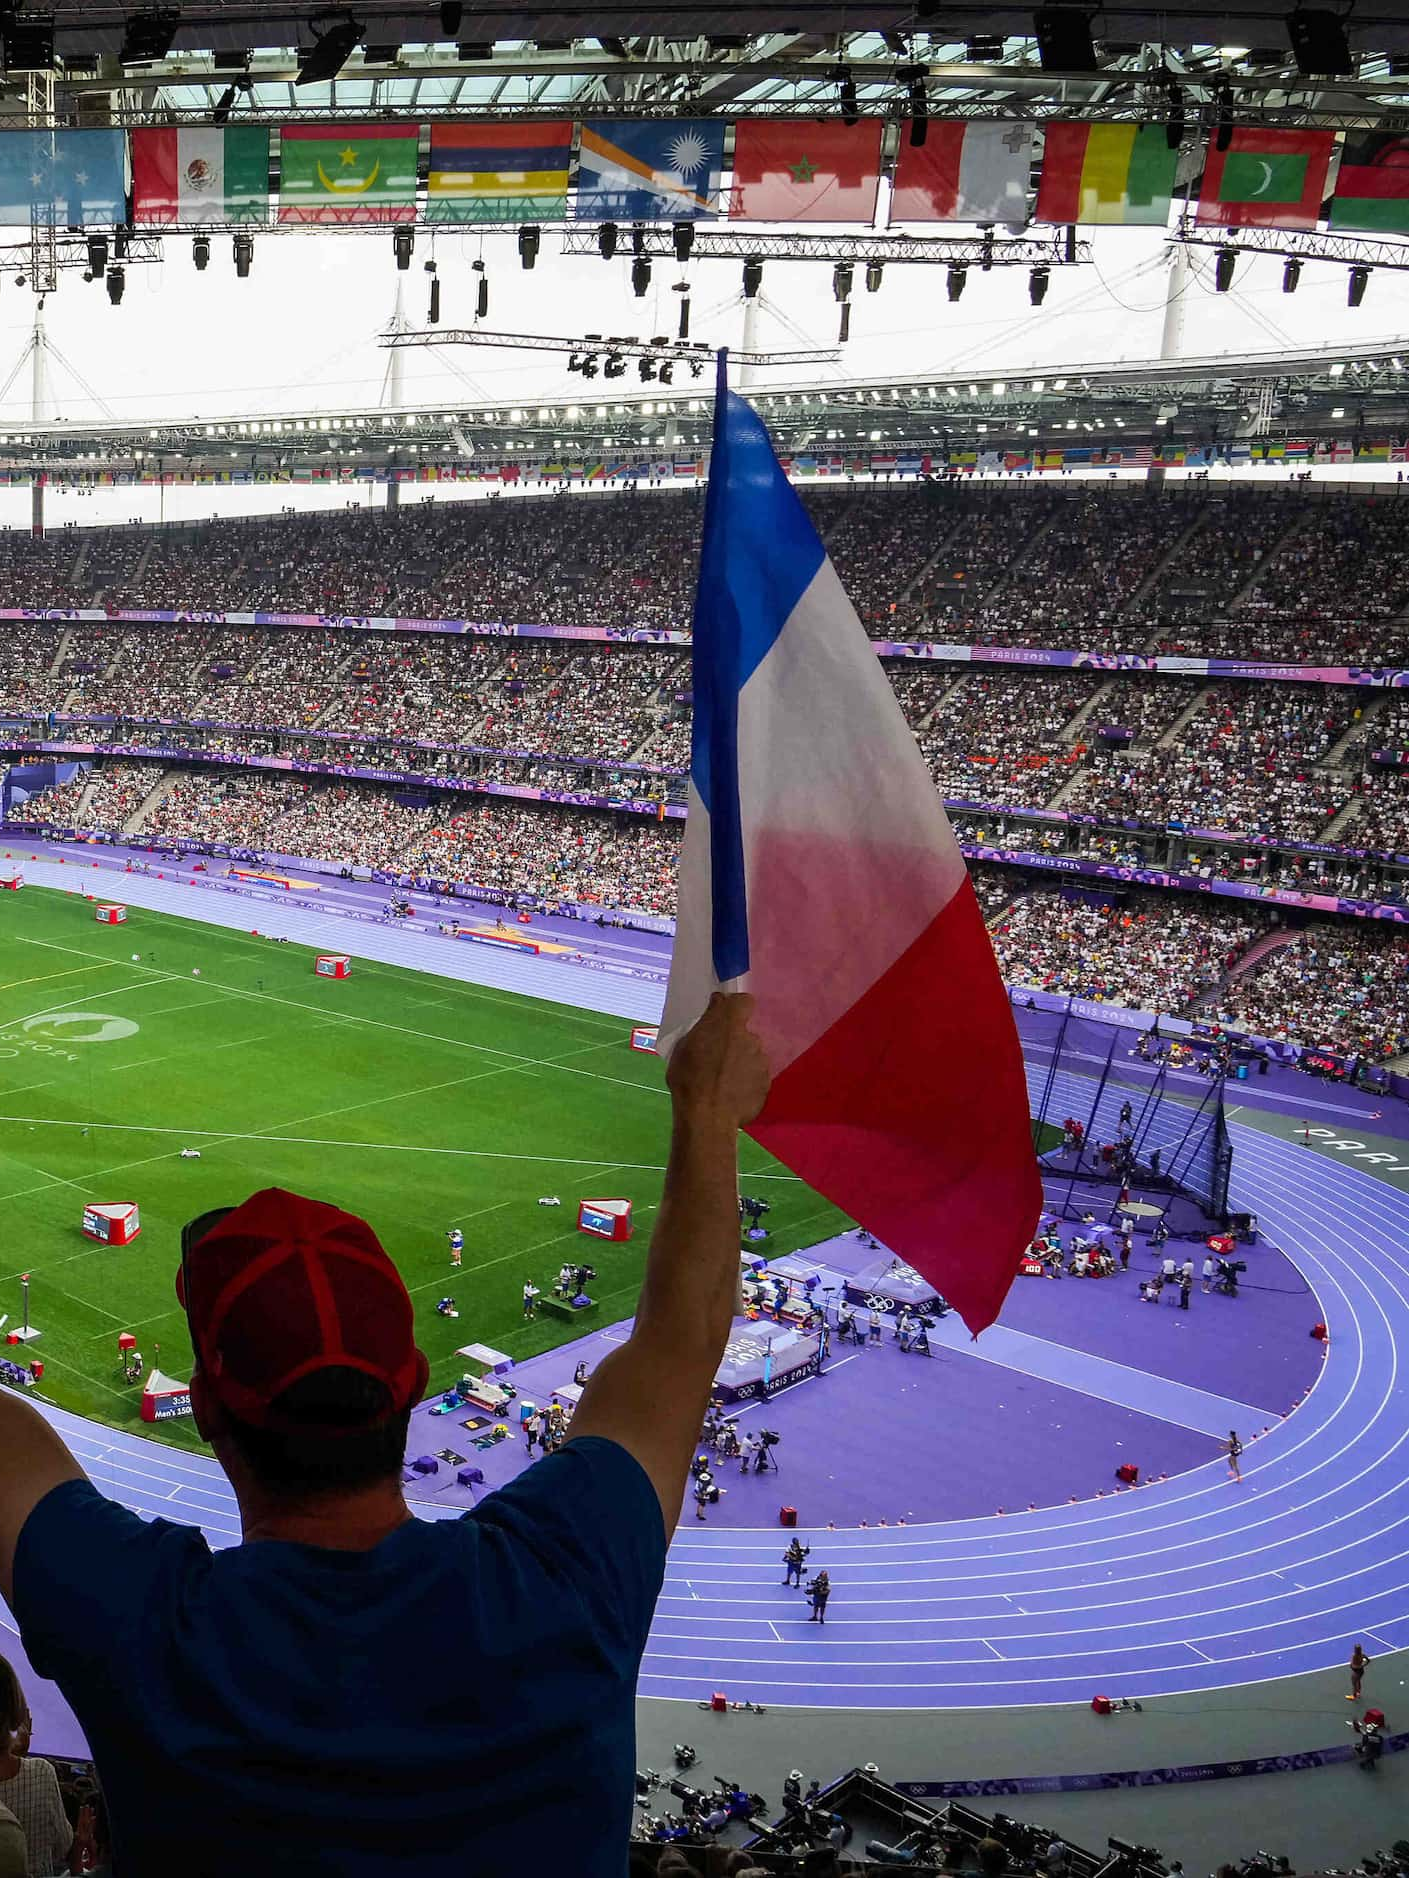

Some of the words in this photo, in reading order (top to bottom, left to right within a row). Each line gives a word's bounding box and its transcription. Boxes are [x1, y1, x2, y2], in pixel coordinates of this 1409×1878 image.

[991, 652, 1020, 660] PARIS
[1023, 653, 1050, 662] 2024
[1030, 858, 1054, 866] PARIS
[1056, 860, 1080, 871] 2024
[462, 888, 484, 898] PARIS
[1063, 1002, 1096, 1017] PARIS
[1100, 1009, 1134, 1025] 2024
[17, 1040, 80, 1062] 2024
[155, 1409, 176, 1420] Men's
